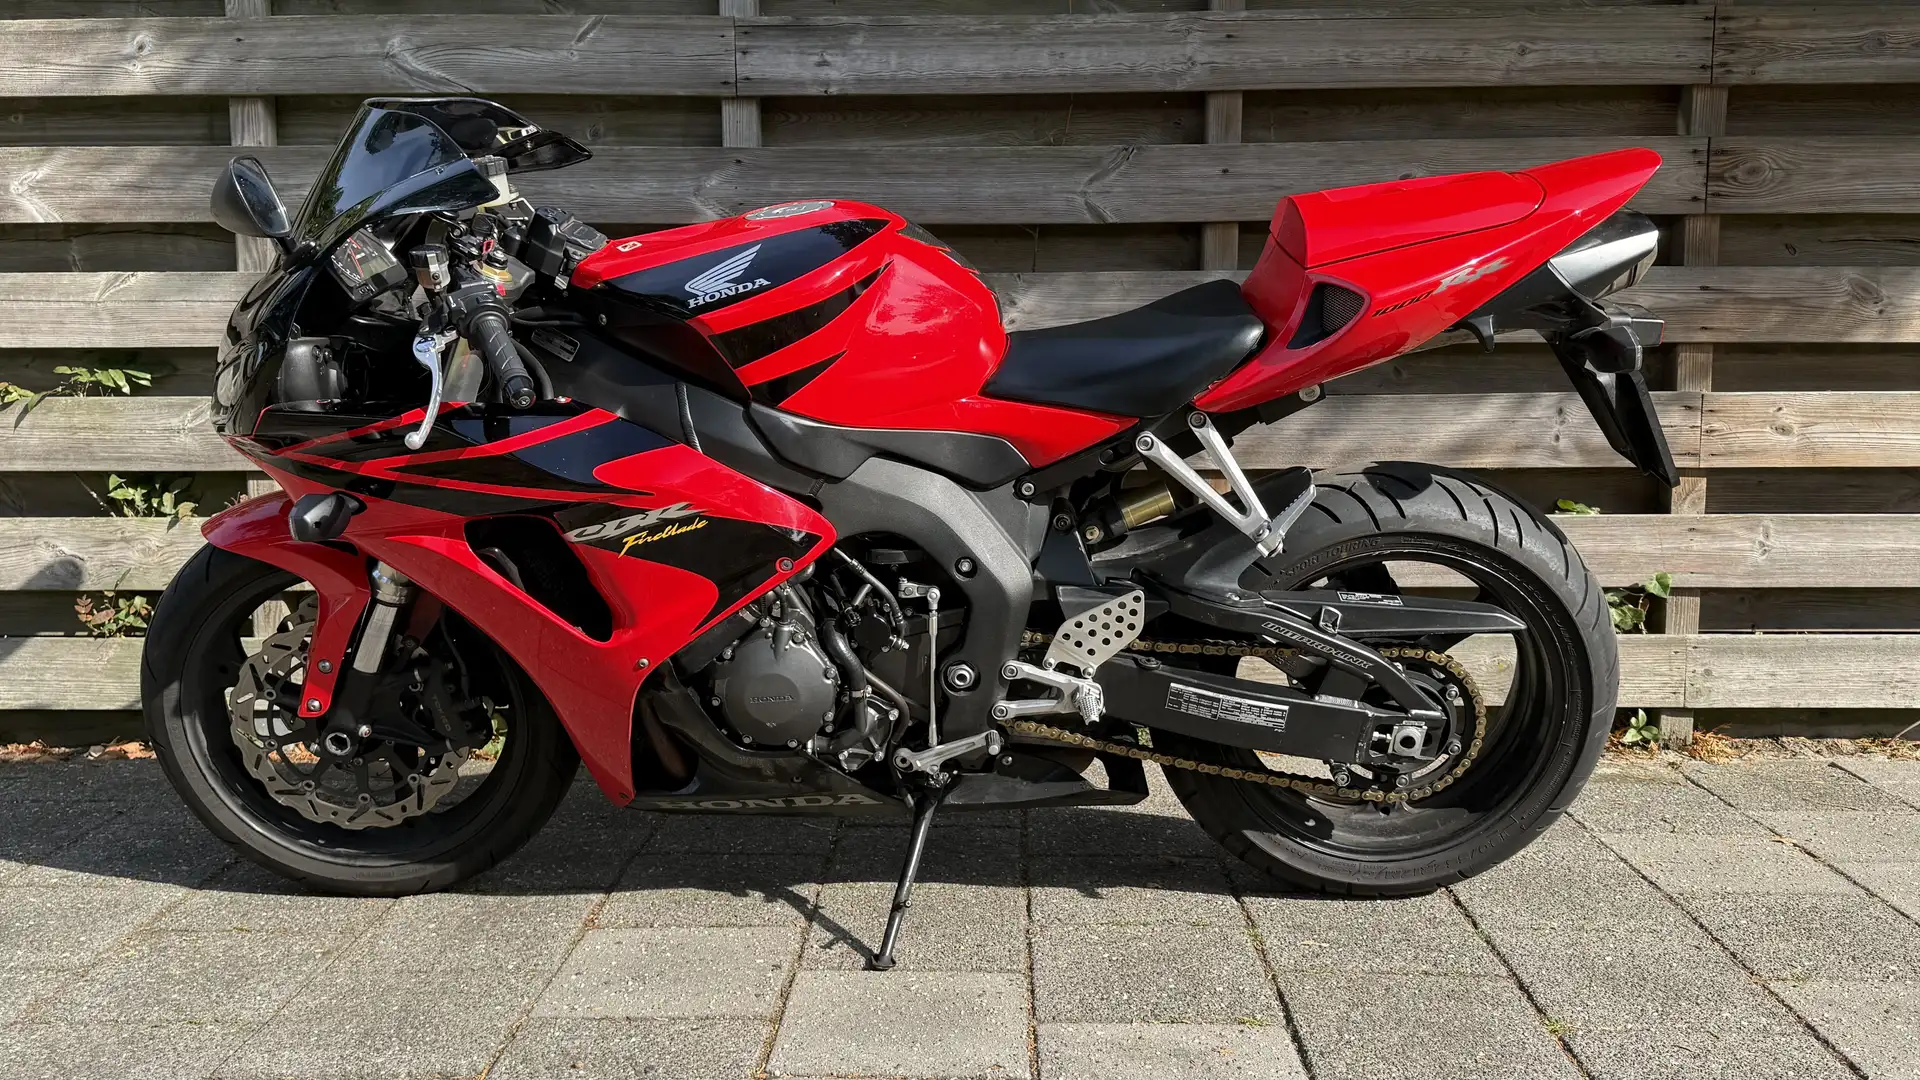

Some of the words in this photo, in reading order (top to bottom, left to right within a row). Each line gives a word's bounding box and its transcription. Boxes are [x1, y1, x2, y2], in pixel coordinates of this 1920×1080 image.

[687, 277, 771, 309] HONDA
[1372, 290, 1433, 317] 1000
[564, 501, 712, 542] CBR
[617, 517, 708, 559] Fireblade
[749, 694, 794, 704] HONDA
[654, 793, 883, 810] HONDA
